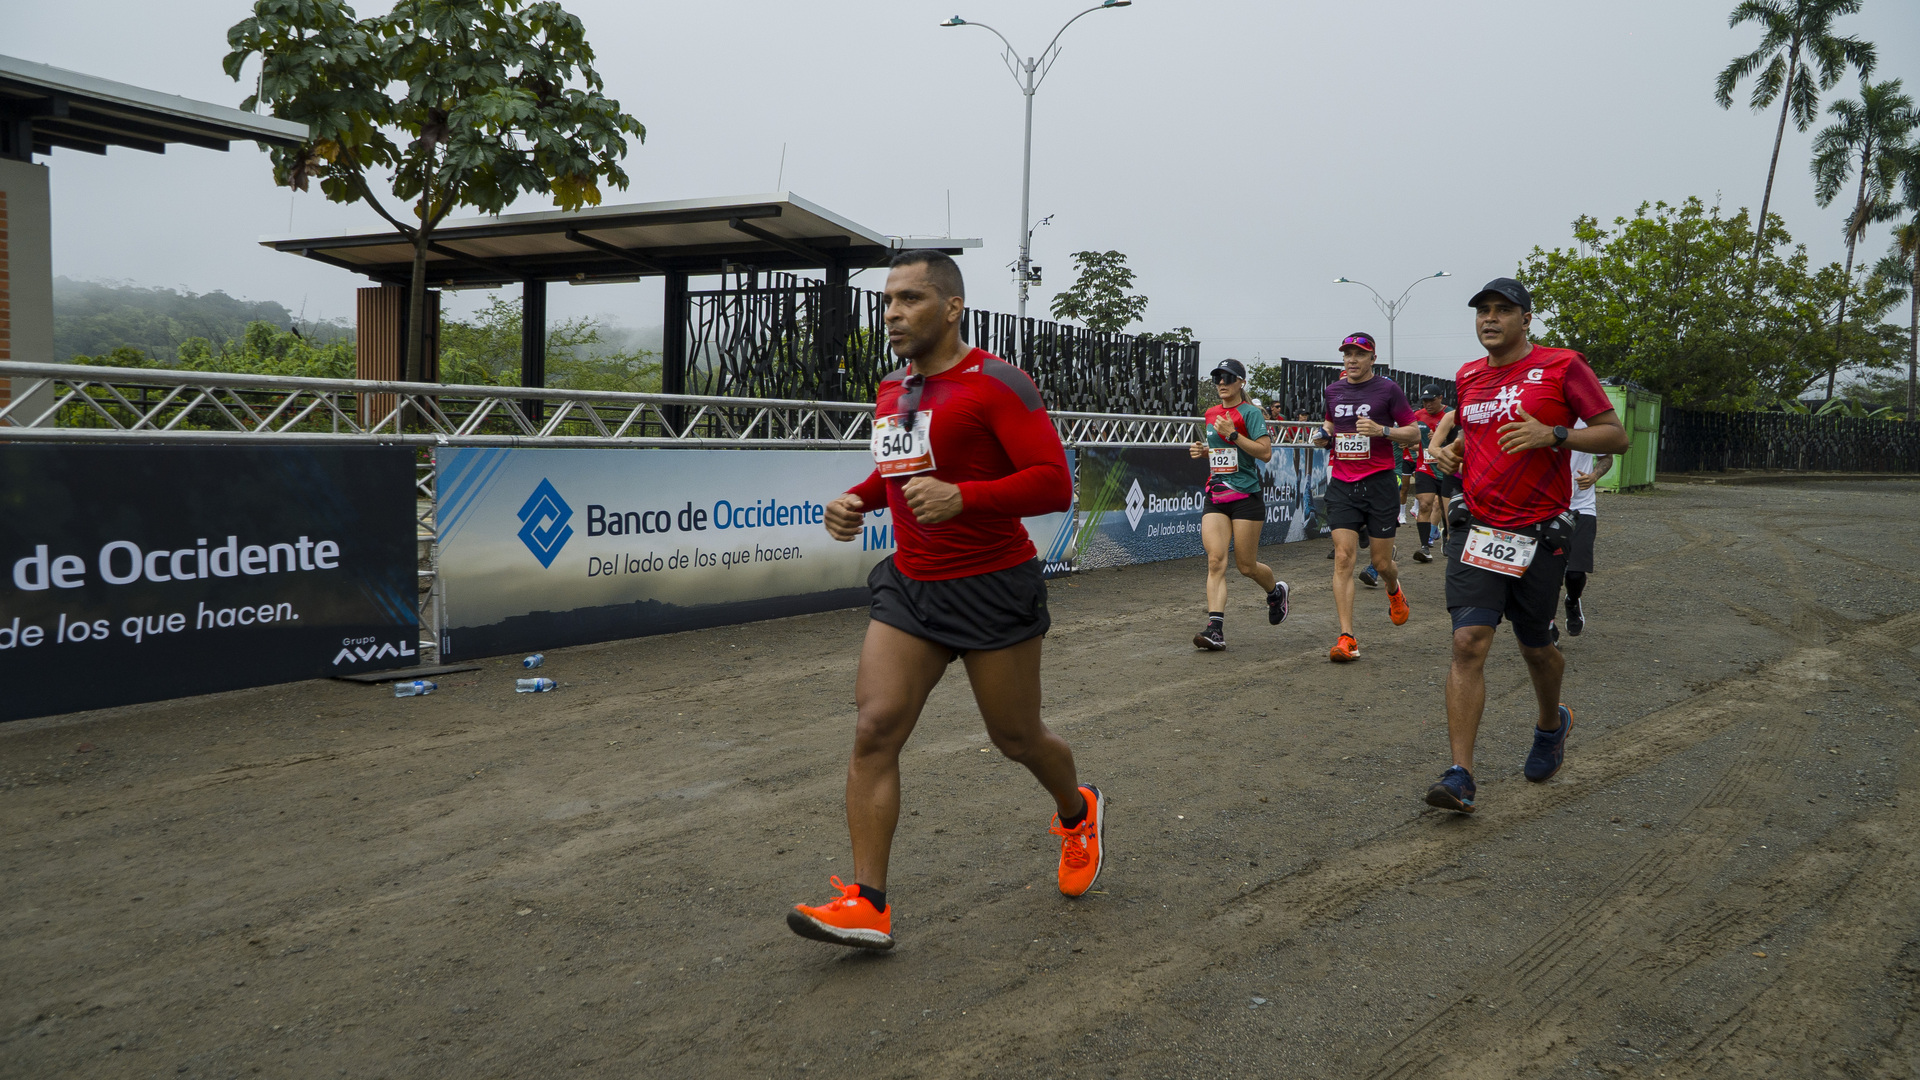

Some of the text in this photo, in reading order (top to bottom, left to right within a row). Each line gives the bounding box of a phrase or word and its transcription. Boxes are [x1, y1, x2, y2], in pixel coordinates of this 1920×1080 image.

[882, 433, 913, 457] 540
[1338, 441, 1363, 451] 1625
[1212, 456, 1229, 466] 192
[1148, 493, 1179, 513] Banco
[1180, 492, 1193, 511] de
[587, 498, 824, 537] Banco de Occidente
[1265, 505, 1293, 523] ACTA.
[862, 524, 896, 551] IM
[1147, 523, 1160, 537] Del
[1160, 522, 1175, 536] lado
[1176, 521, 1185, 534] de
[1186, 520, 1196, 533] los
[588, 543, 803, 577] Del lado de los que hacen.
[1481, 542, 1517, 562] 462
[12, 535, 340, 591] de Occidente
[1042, 561, 1070, 573] AVAL
[0, 601, 299, 649] de los que hacen.
[342, 636, 375, 646] Grupo
[332, 640, 415, 666] AVAL
